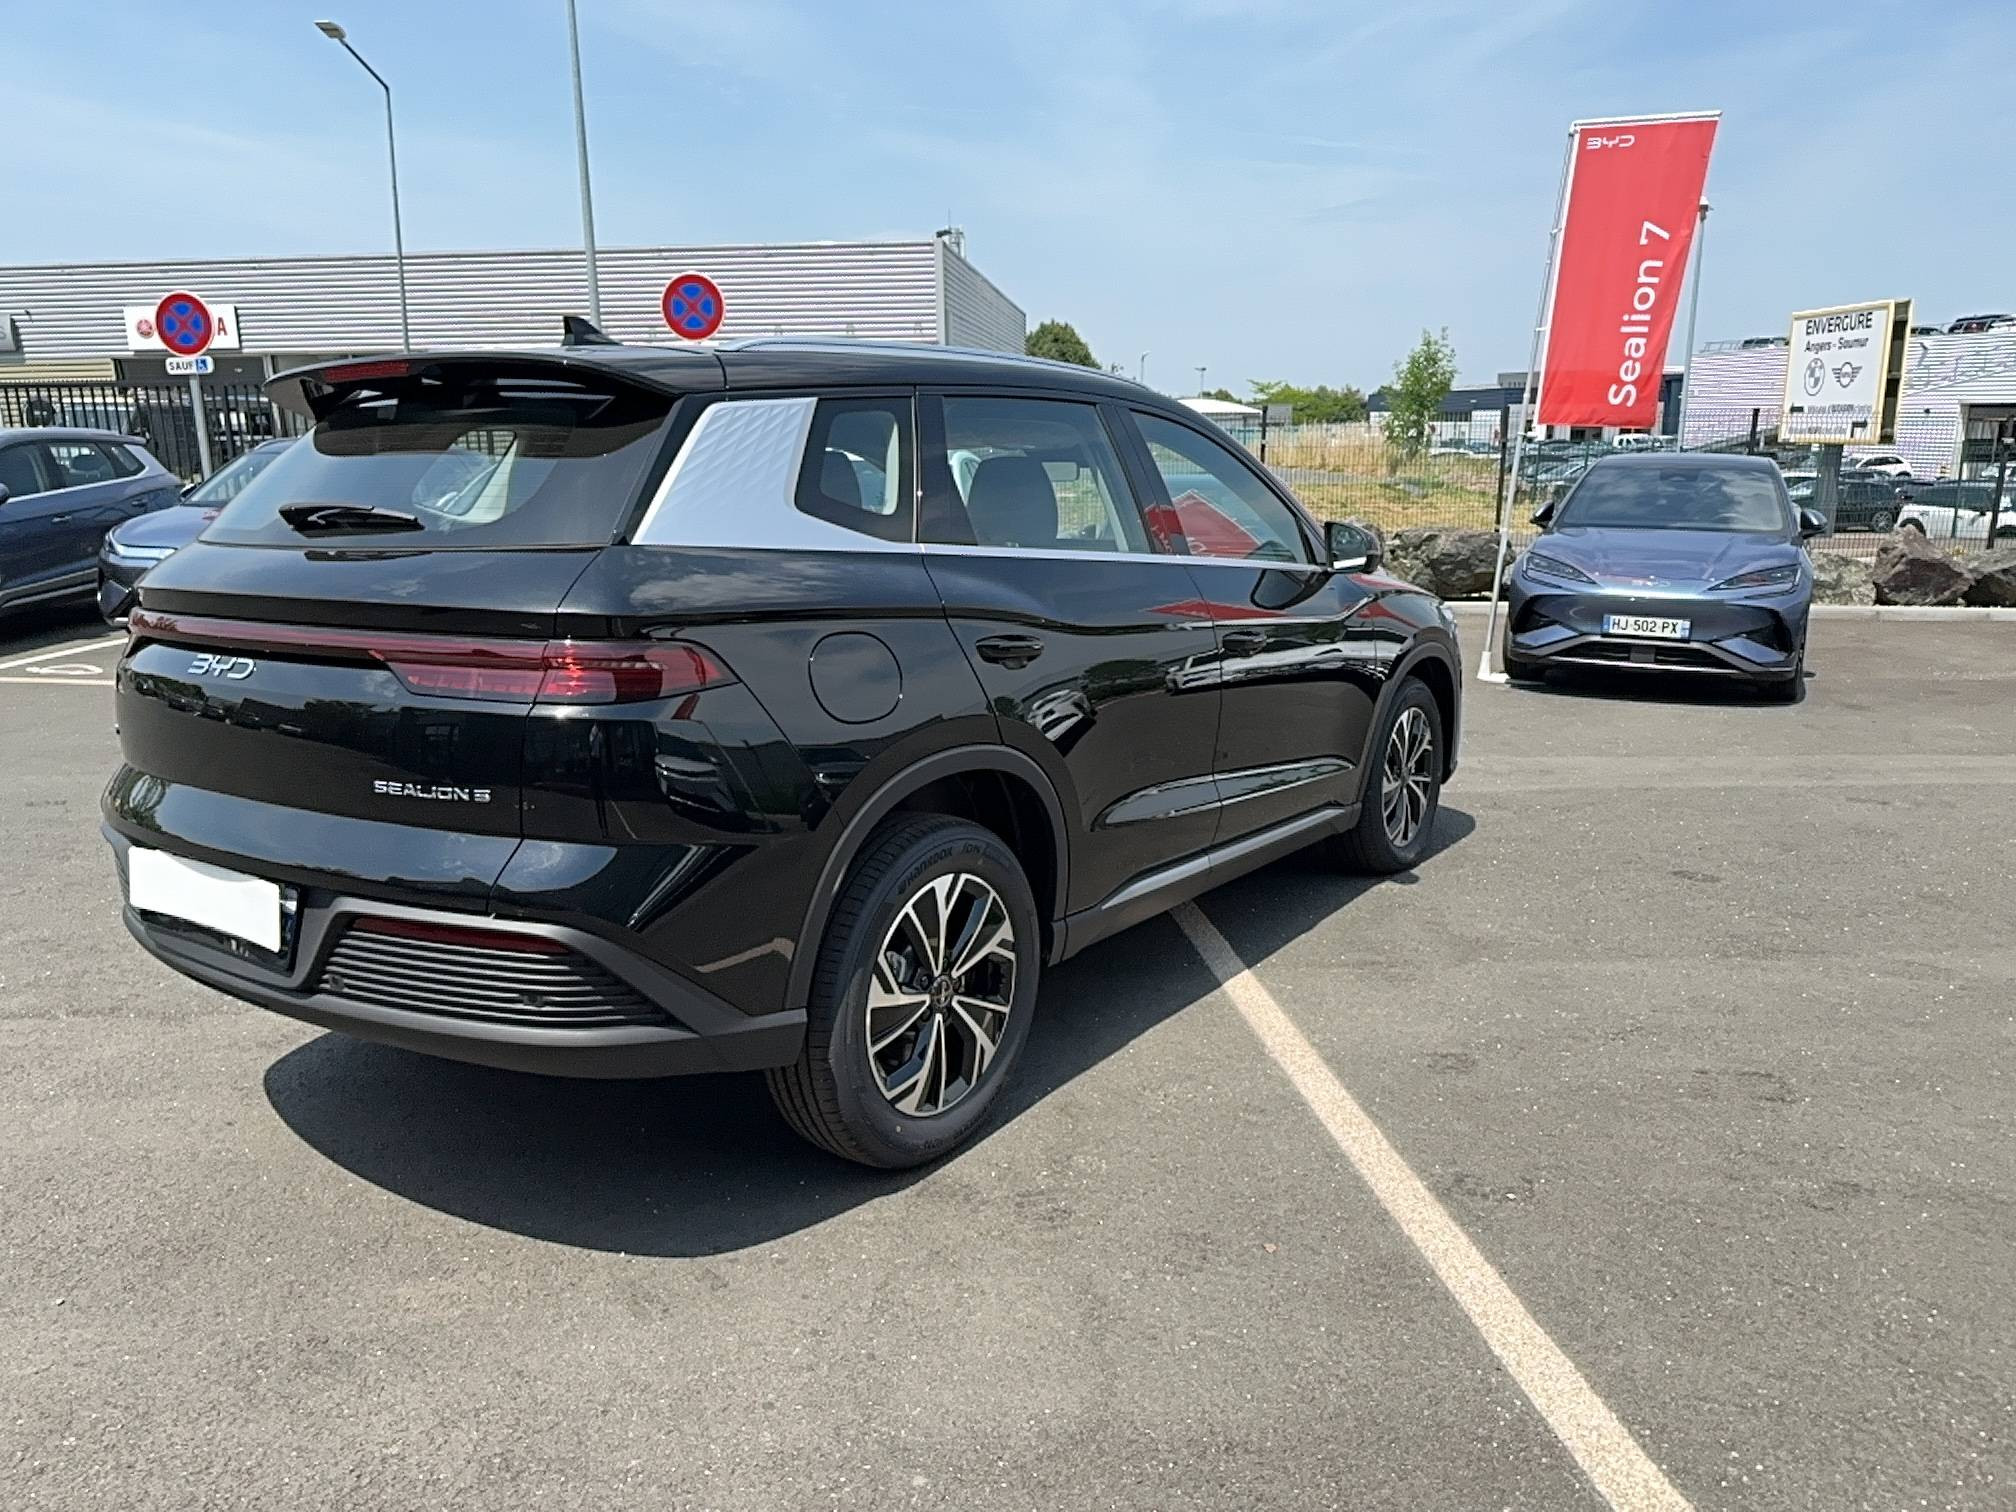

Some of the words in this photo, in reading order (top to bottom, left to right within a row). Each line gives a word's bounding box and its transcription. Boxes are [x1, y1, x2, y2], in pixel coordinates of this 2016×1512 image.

[1586, 135, 1635, 149] BYD
[1608, 259, 1664, 407] Sealion
[1639, 220, 1671, 246] 7
[1806, 312, 1873, 336] ENVERGURE
[1804, 340, 1832, 354] Angers
[169, 360, 193, 371] SAUF
[187, 653, 254, 680] BYD
[373, 780, 470, 801] SEALION
[473, 789, 492, 803] 5
